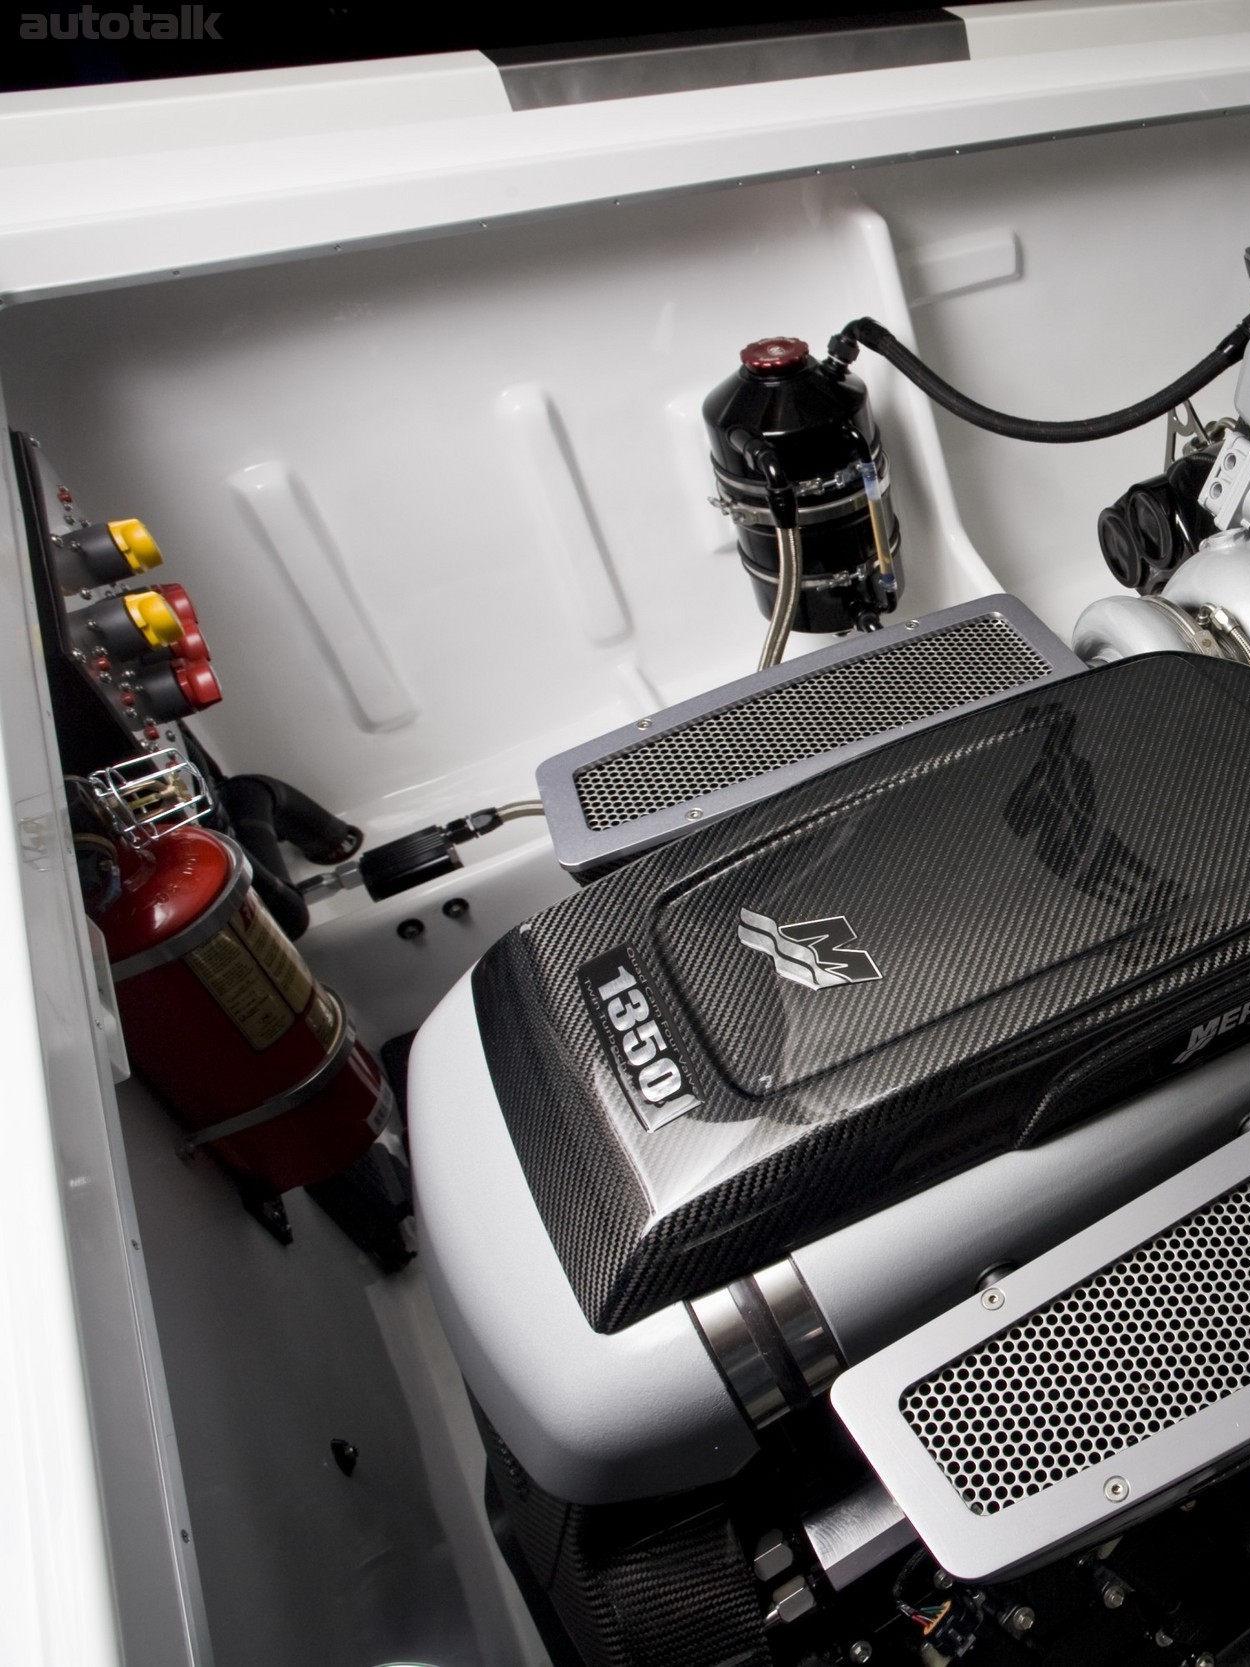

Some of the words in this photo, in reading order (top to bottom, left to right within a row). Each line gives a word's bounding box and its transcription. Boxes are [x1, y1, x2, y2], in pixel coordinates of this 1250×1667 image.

[584, 978, 601, 1011] Twin
[598, 965, 681, 1103] 1350
[627, 947, 647, 983] Quad
[644, 986, 662, 1018] Cam
[661, 1020, 680, 1052] Four
[678, 1054, 700, 1096] Valve
